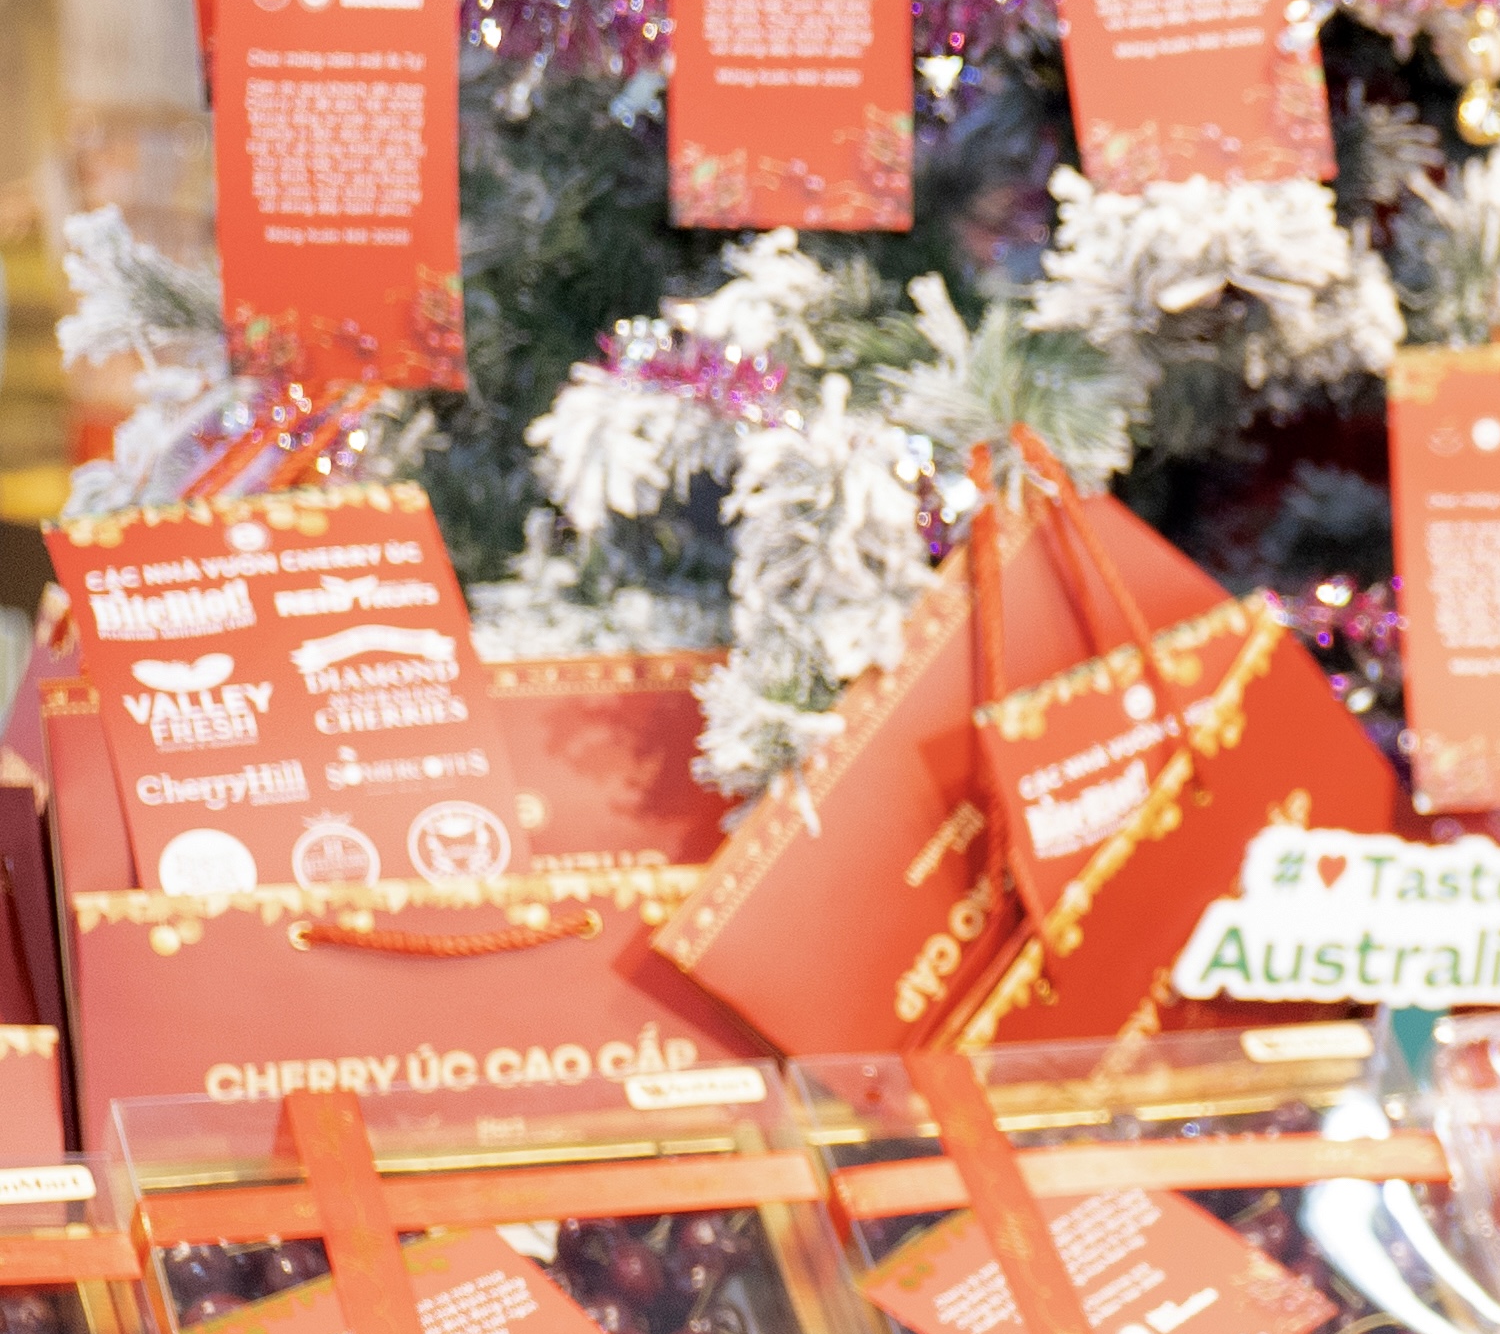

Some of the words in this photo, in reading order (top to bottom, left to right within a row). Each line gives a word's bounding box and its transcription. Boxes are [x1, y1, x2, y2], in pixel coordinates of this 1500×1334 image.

[123, 680, 274, 726] VALLEY
[150, 710, 260, 747] FRESH
[485, 1042, 593, 1087] CAO
